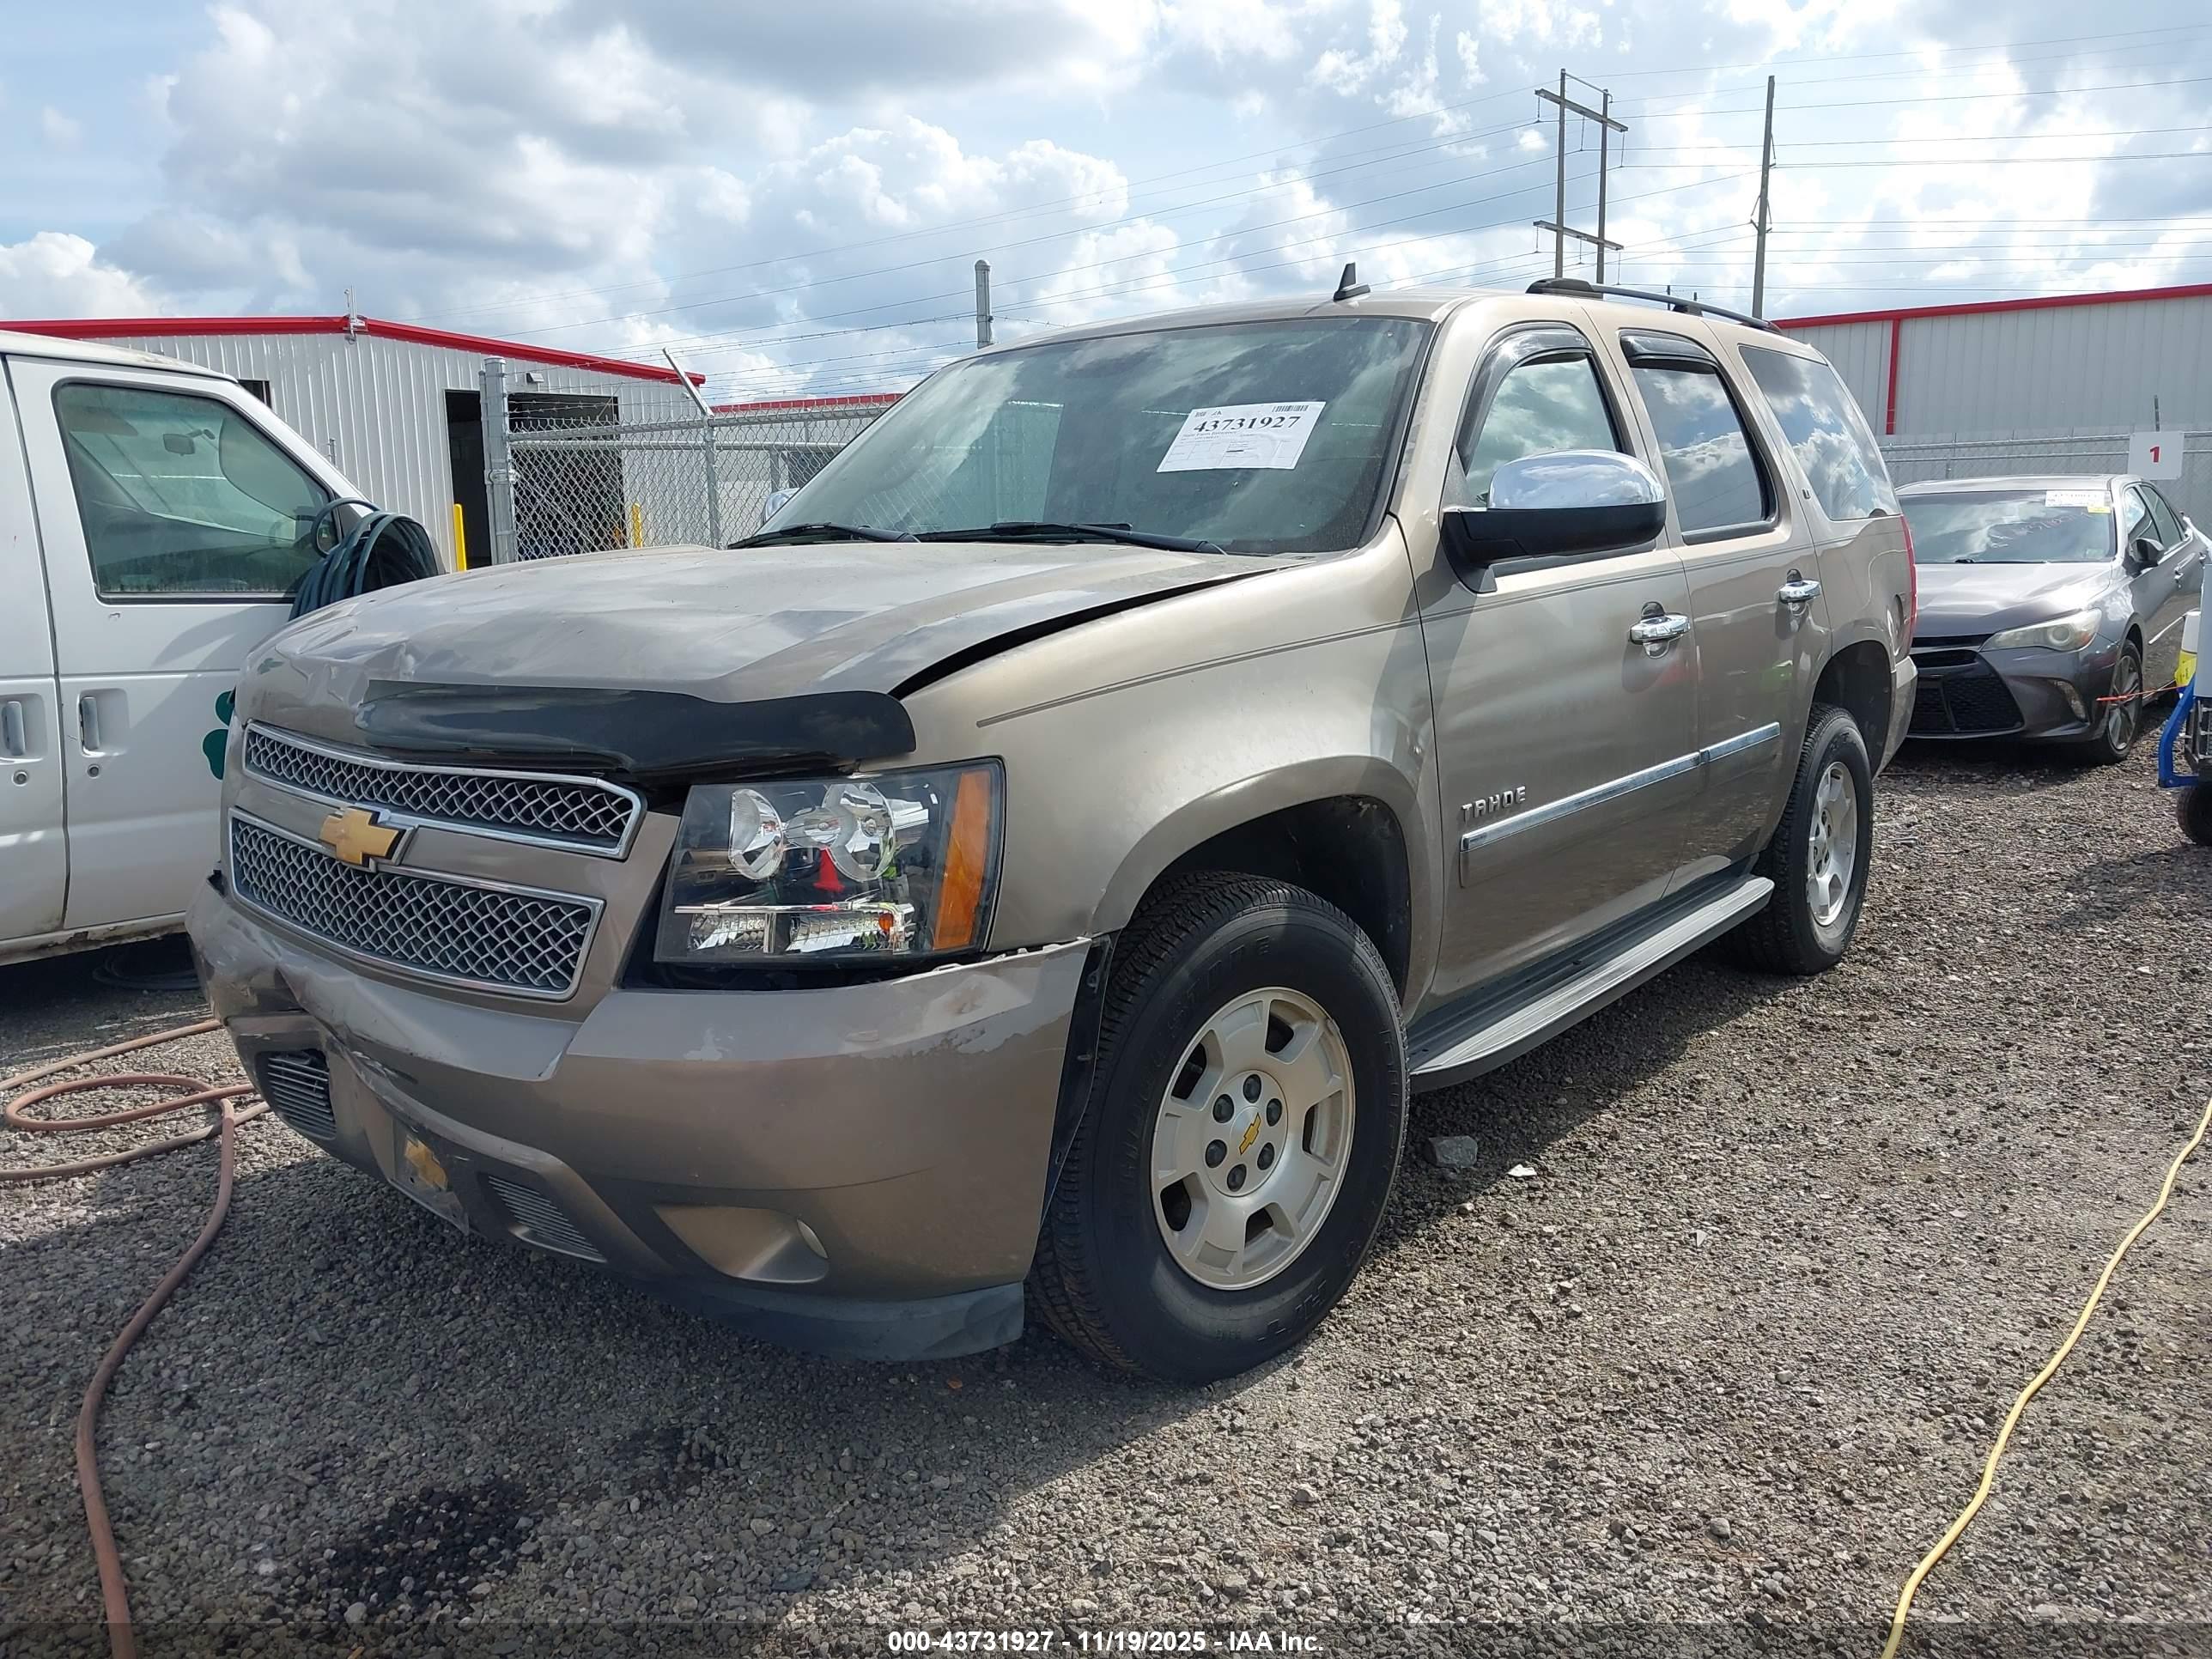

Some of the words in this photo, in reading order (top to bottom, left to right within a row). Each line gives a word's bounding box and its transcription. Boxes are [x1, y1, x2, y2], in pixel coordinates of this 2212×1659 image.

[1194, 416, 1302, 433] 43731927
[2149, 446, 2160, 463] 1
[1462, 786, 1526, 824] TAHOE
